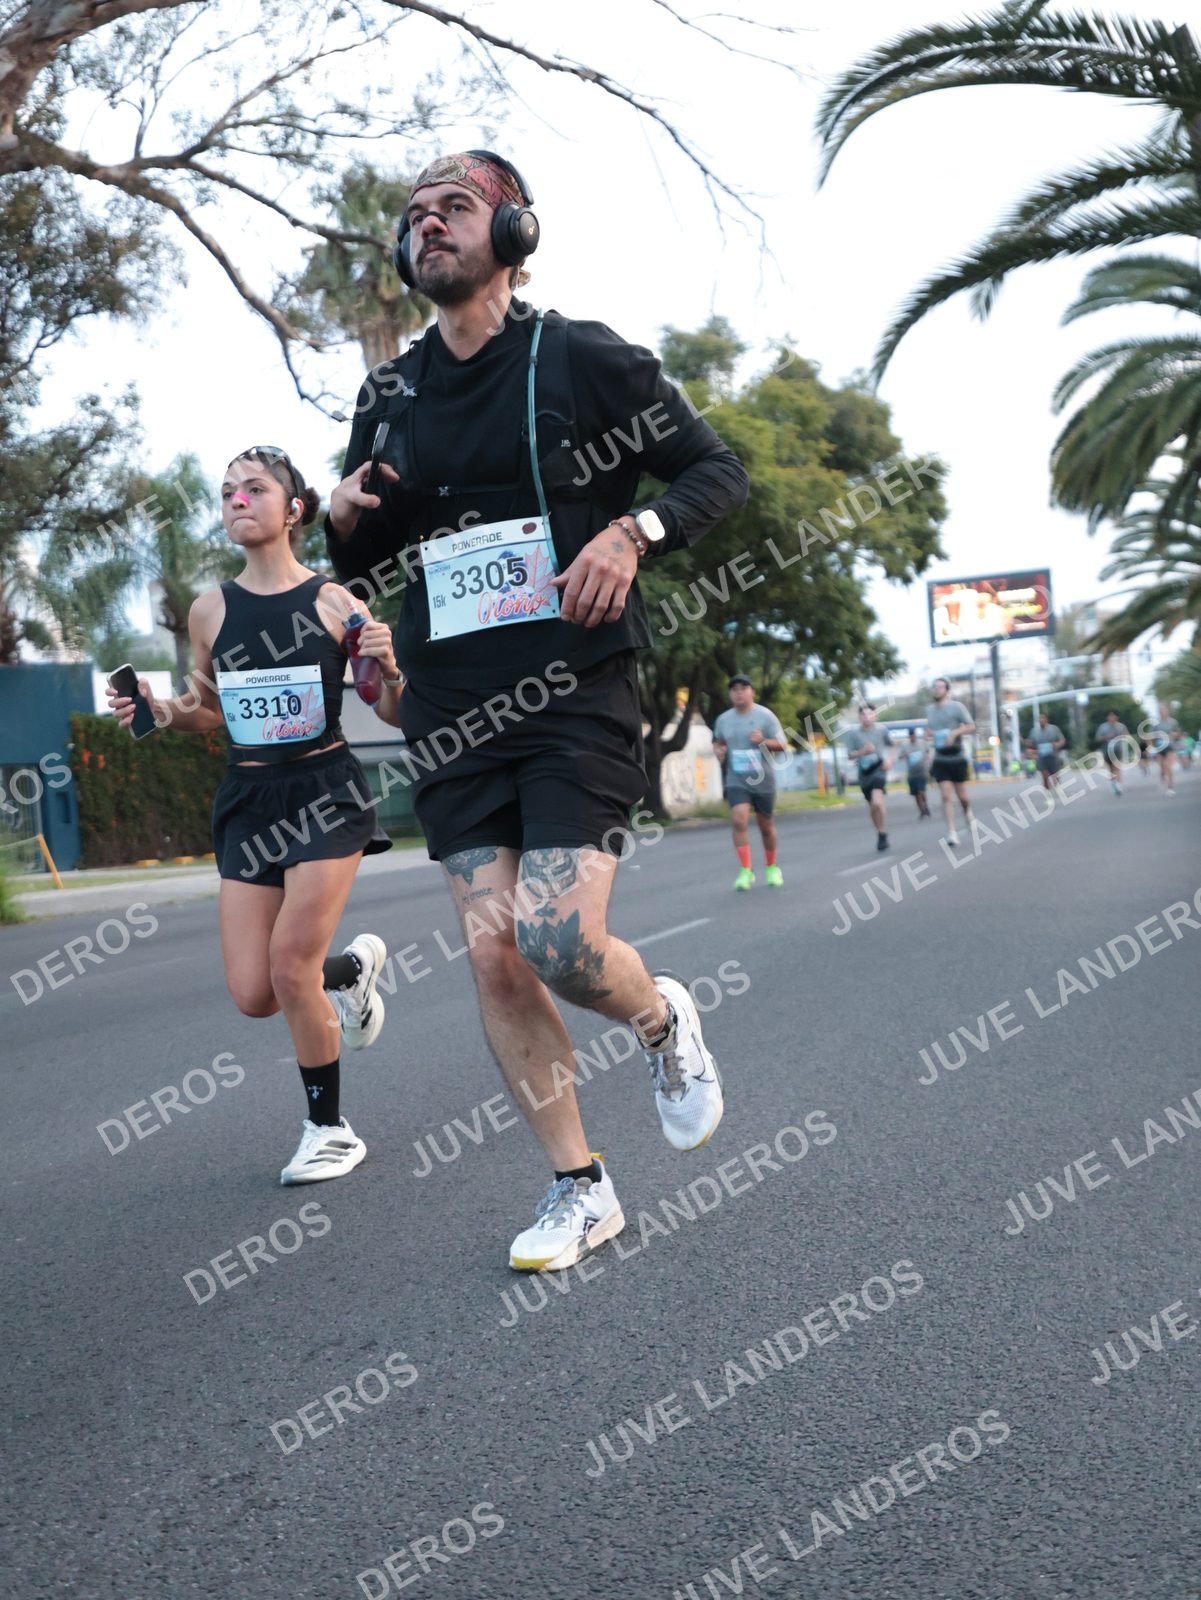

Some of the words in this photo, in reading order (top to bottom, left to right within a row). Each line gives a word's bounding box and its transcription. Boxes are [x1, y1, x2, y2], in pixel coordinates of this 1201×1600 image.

[452, 531, 503, 552] POWERADE
[450, 557, 528, 599] 3305
[246, 674, 292, 685] POWERADE
[239, 694, 302, 720] 3310
